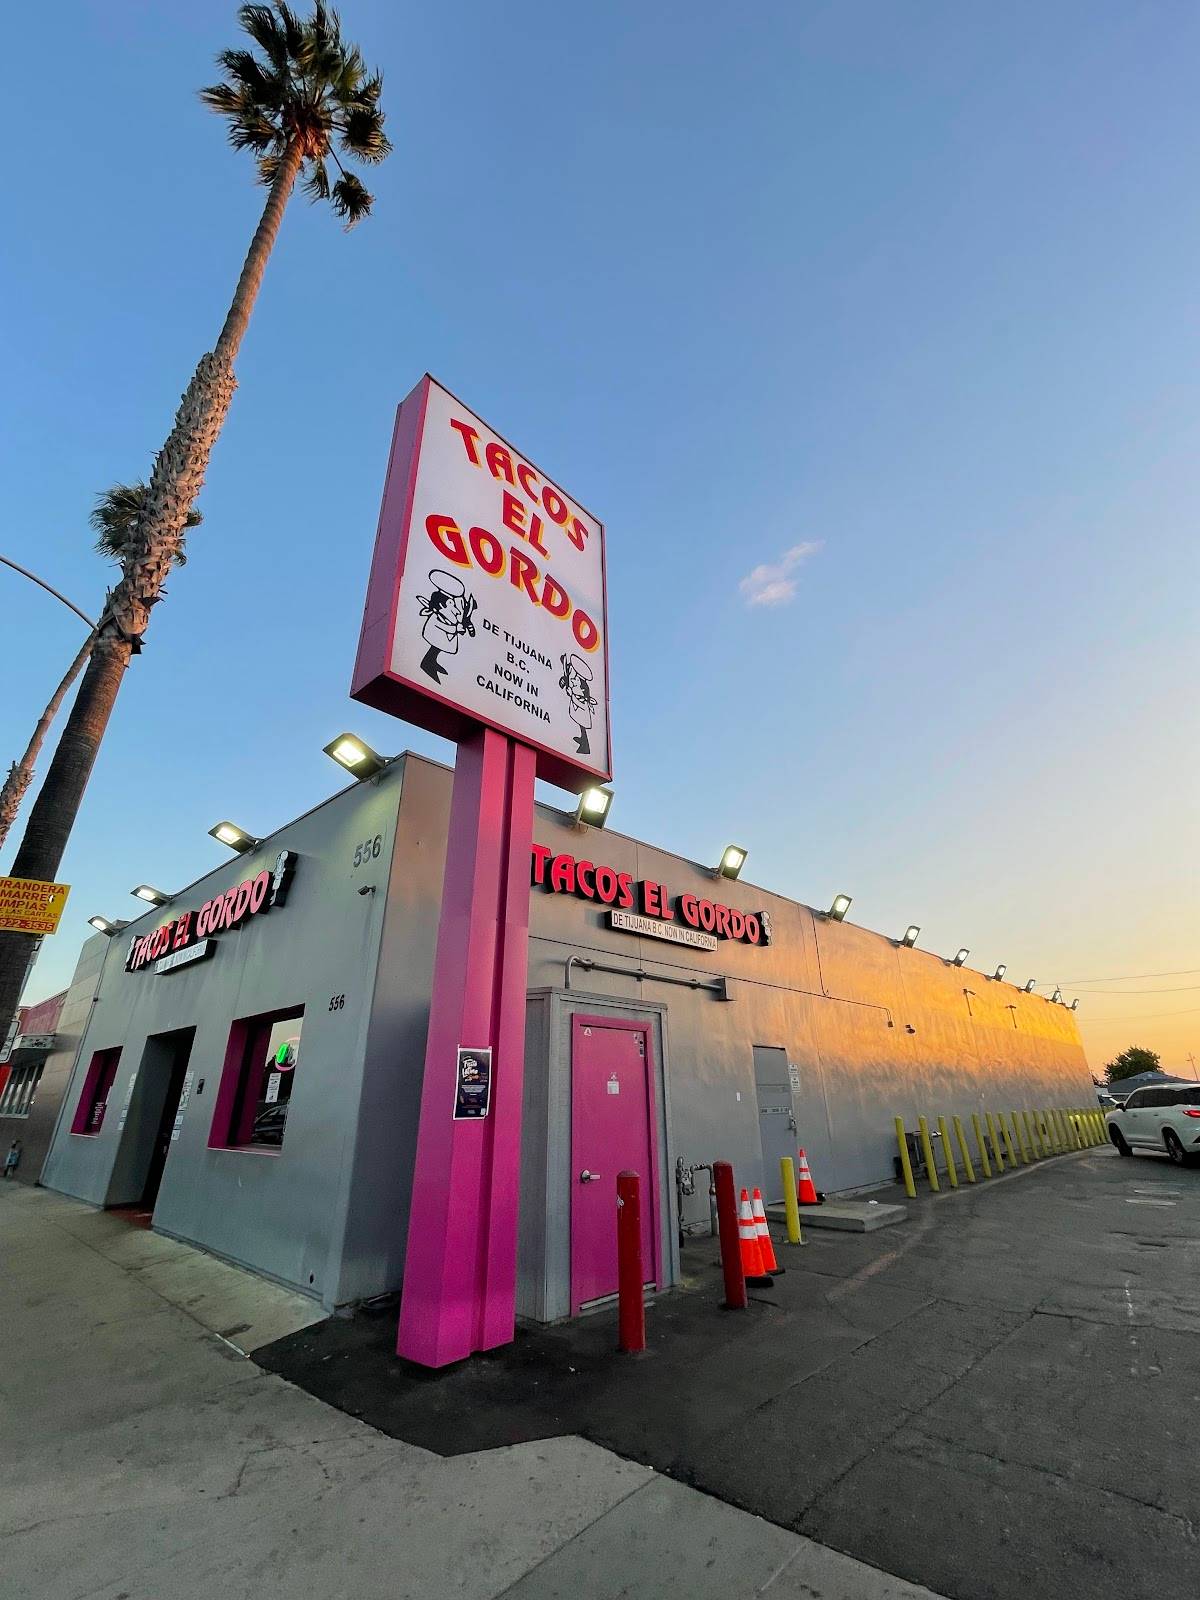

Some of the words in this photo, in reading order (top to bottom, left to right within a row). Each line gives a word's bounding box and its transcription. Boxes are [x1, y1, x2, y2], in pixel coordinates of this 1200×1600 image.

[450, 418, 589, 552] TACOS
[502, 489, 549, 560] EL
[425, 514, 600, 653] GORDO
[482, 618, 499, 636] DE
[503, 630, 553, 670] TIJUANA
[506, 651, 530, 674] B.C.
[476, 675, 551, 724] CALIFORNIA
[494, 663, 523, 688] NOW
[526, 682, 538, 697] IN
[353, 834, 382, 868] 556
[532, 843, 634, 909] TACOS
[643, 879, 675, 920] EL
[681, 893, 761, 944] GORDO
[131, 921, 174, 971] TACOS
[173, 912, 191, 949] EL
[196, 869, 270, 937] GORDO
[613, 912, 623, 926] DE
[624, 915, 652, 932] TIJUANA
[664, 926, 678, 938] NOW
[678, 932, 685, 941] IN
[685, 931, 717, 948] CALIFORNIA
[328, 994, 345, 1012] 556
